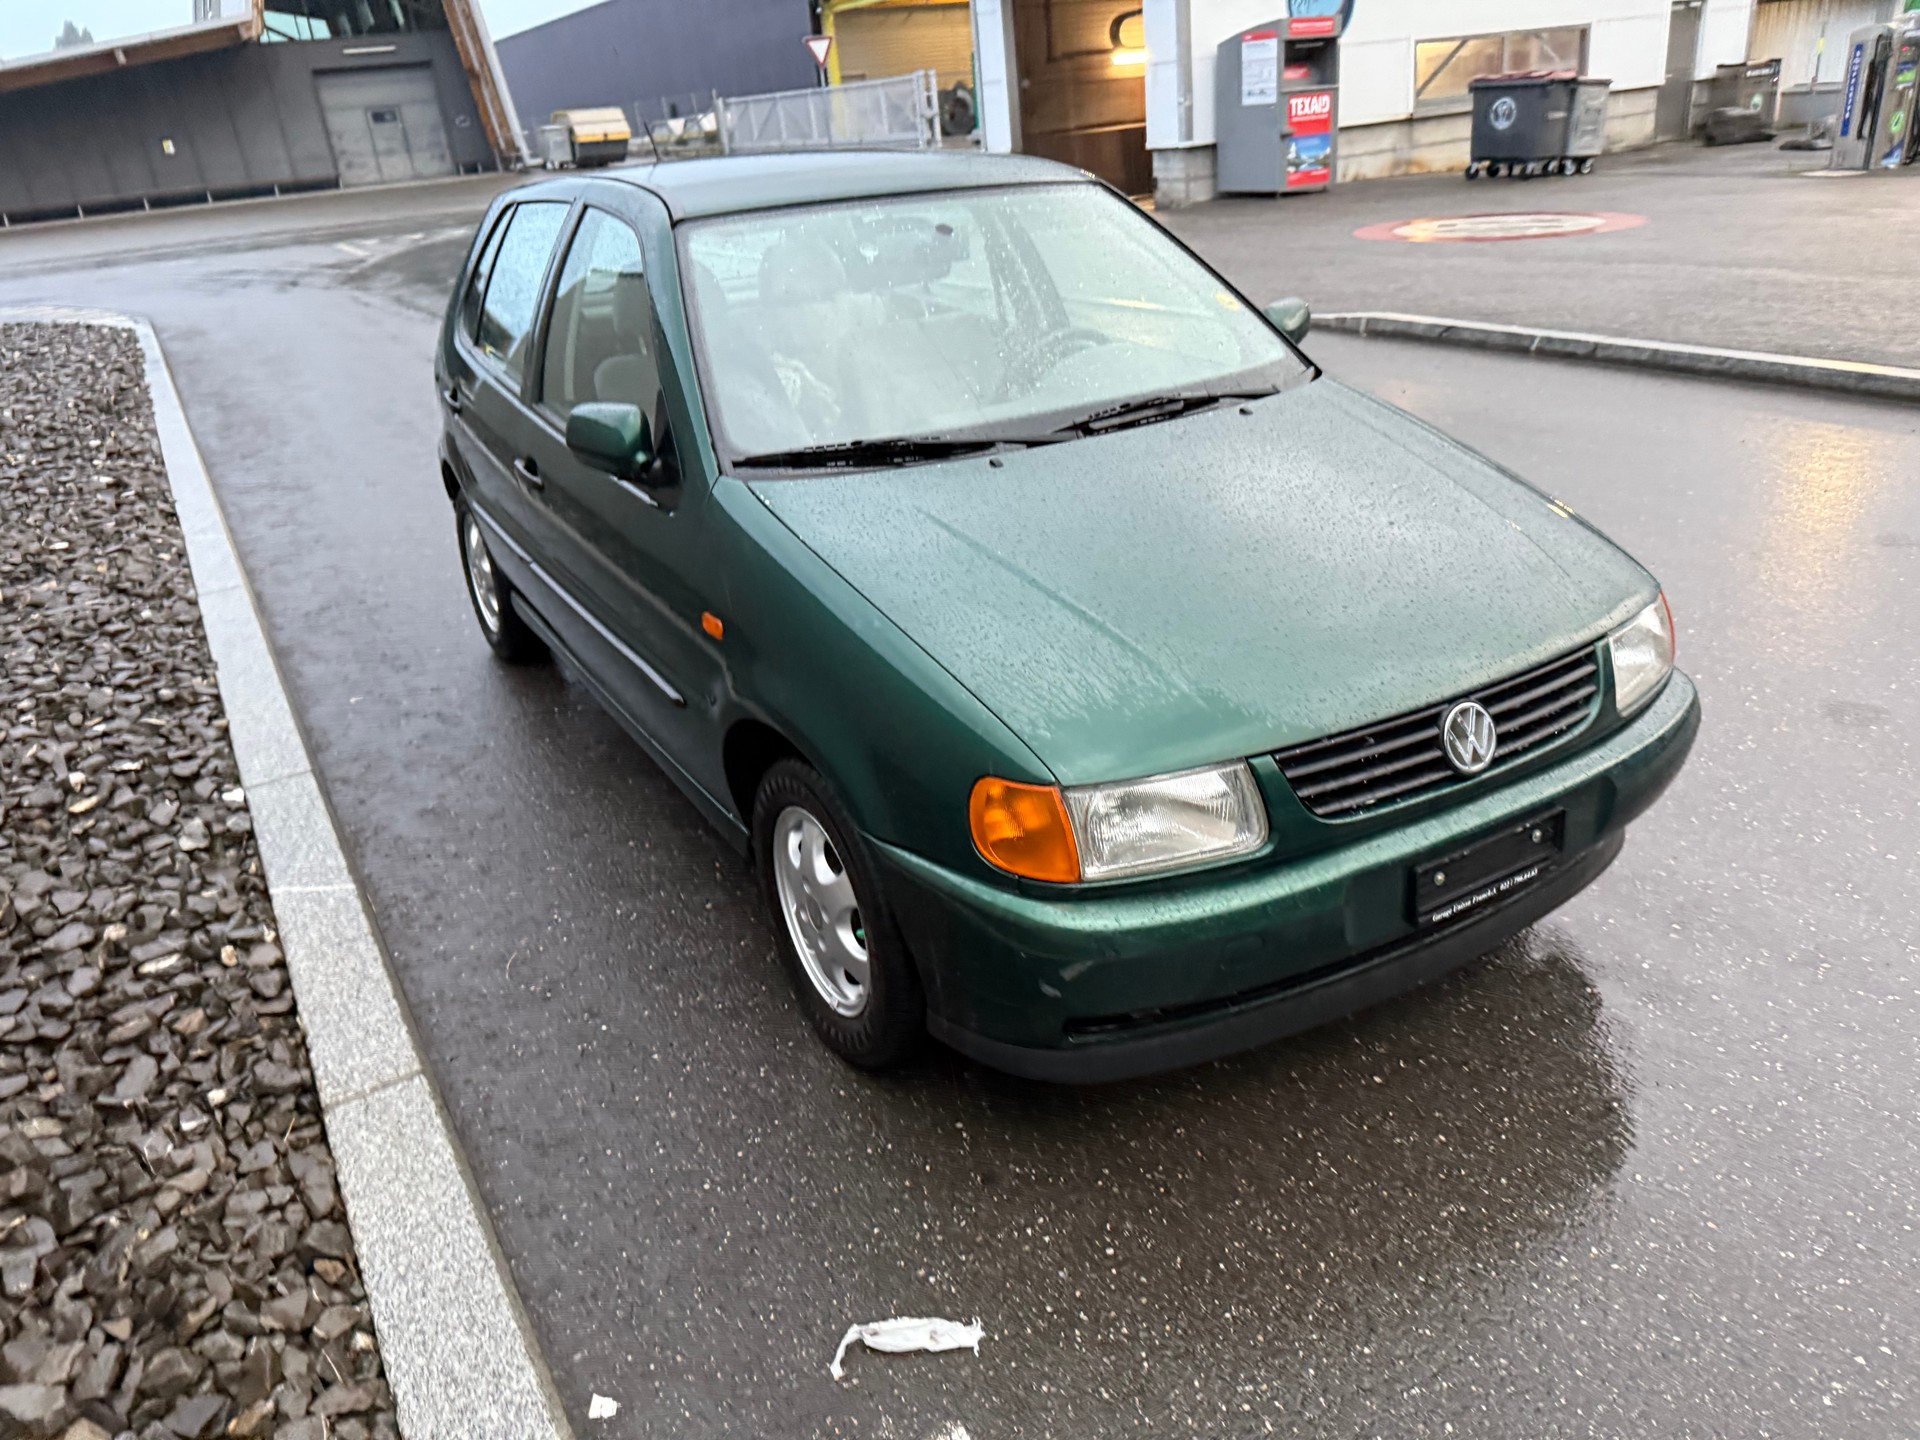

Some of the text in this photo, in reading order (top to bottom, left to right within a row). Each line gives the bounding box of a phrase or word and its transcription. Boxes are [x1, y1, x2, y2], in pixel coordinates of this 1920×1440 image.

[1290, 94, 1330, 116] TEXAID
[1445, 702, 1496, 772] VW
[1432, 908, 1453, 922] Garage
